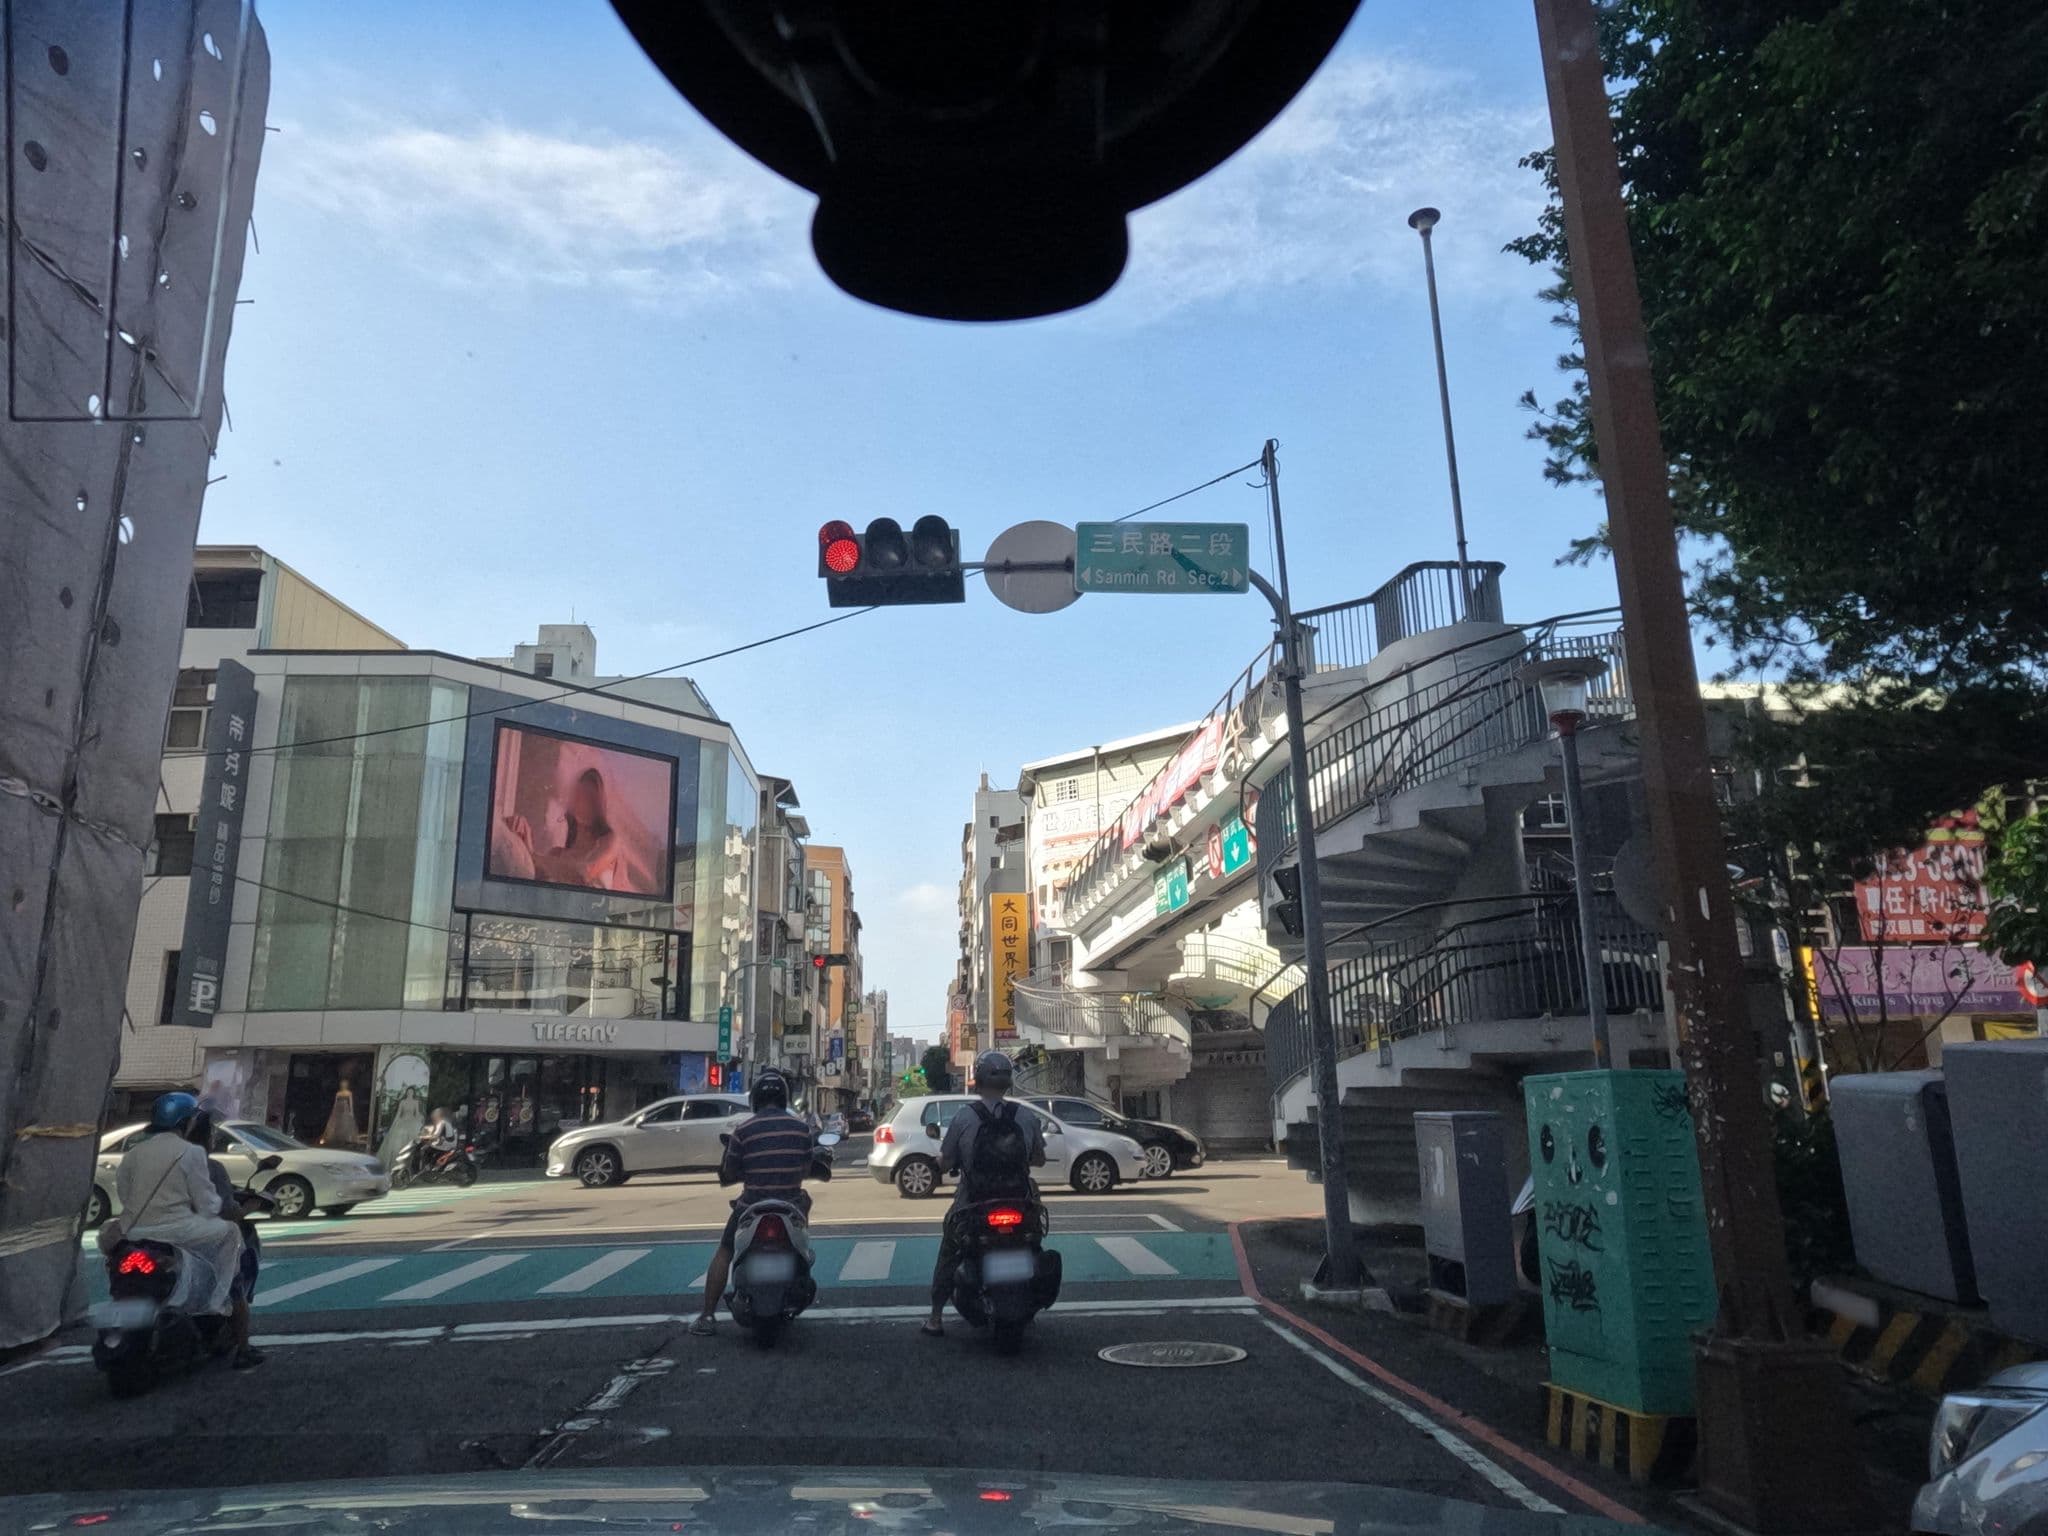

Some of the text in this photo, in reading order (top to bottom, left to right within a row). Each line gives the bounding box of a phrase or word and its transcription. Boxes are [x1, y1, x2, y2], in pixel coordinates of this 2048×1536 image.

[1091, 531, 1233, 556] 三民路二段
[1095, 569, 1229, 585] Sanmin Rd. Sec.2
[1904, 993, 1945, 1007] Wang
[532, 1021, 618, 1043] TIFFANY
